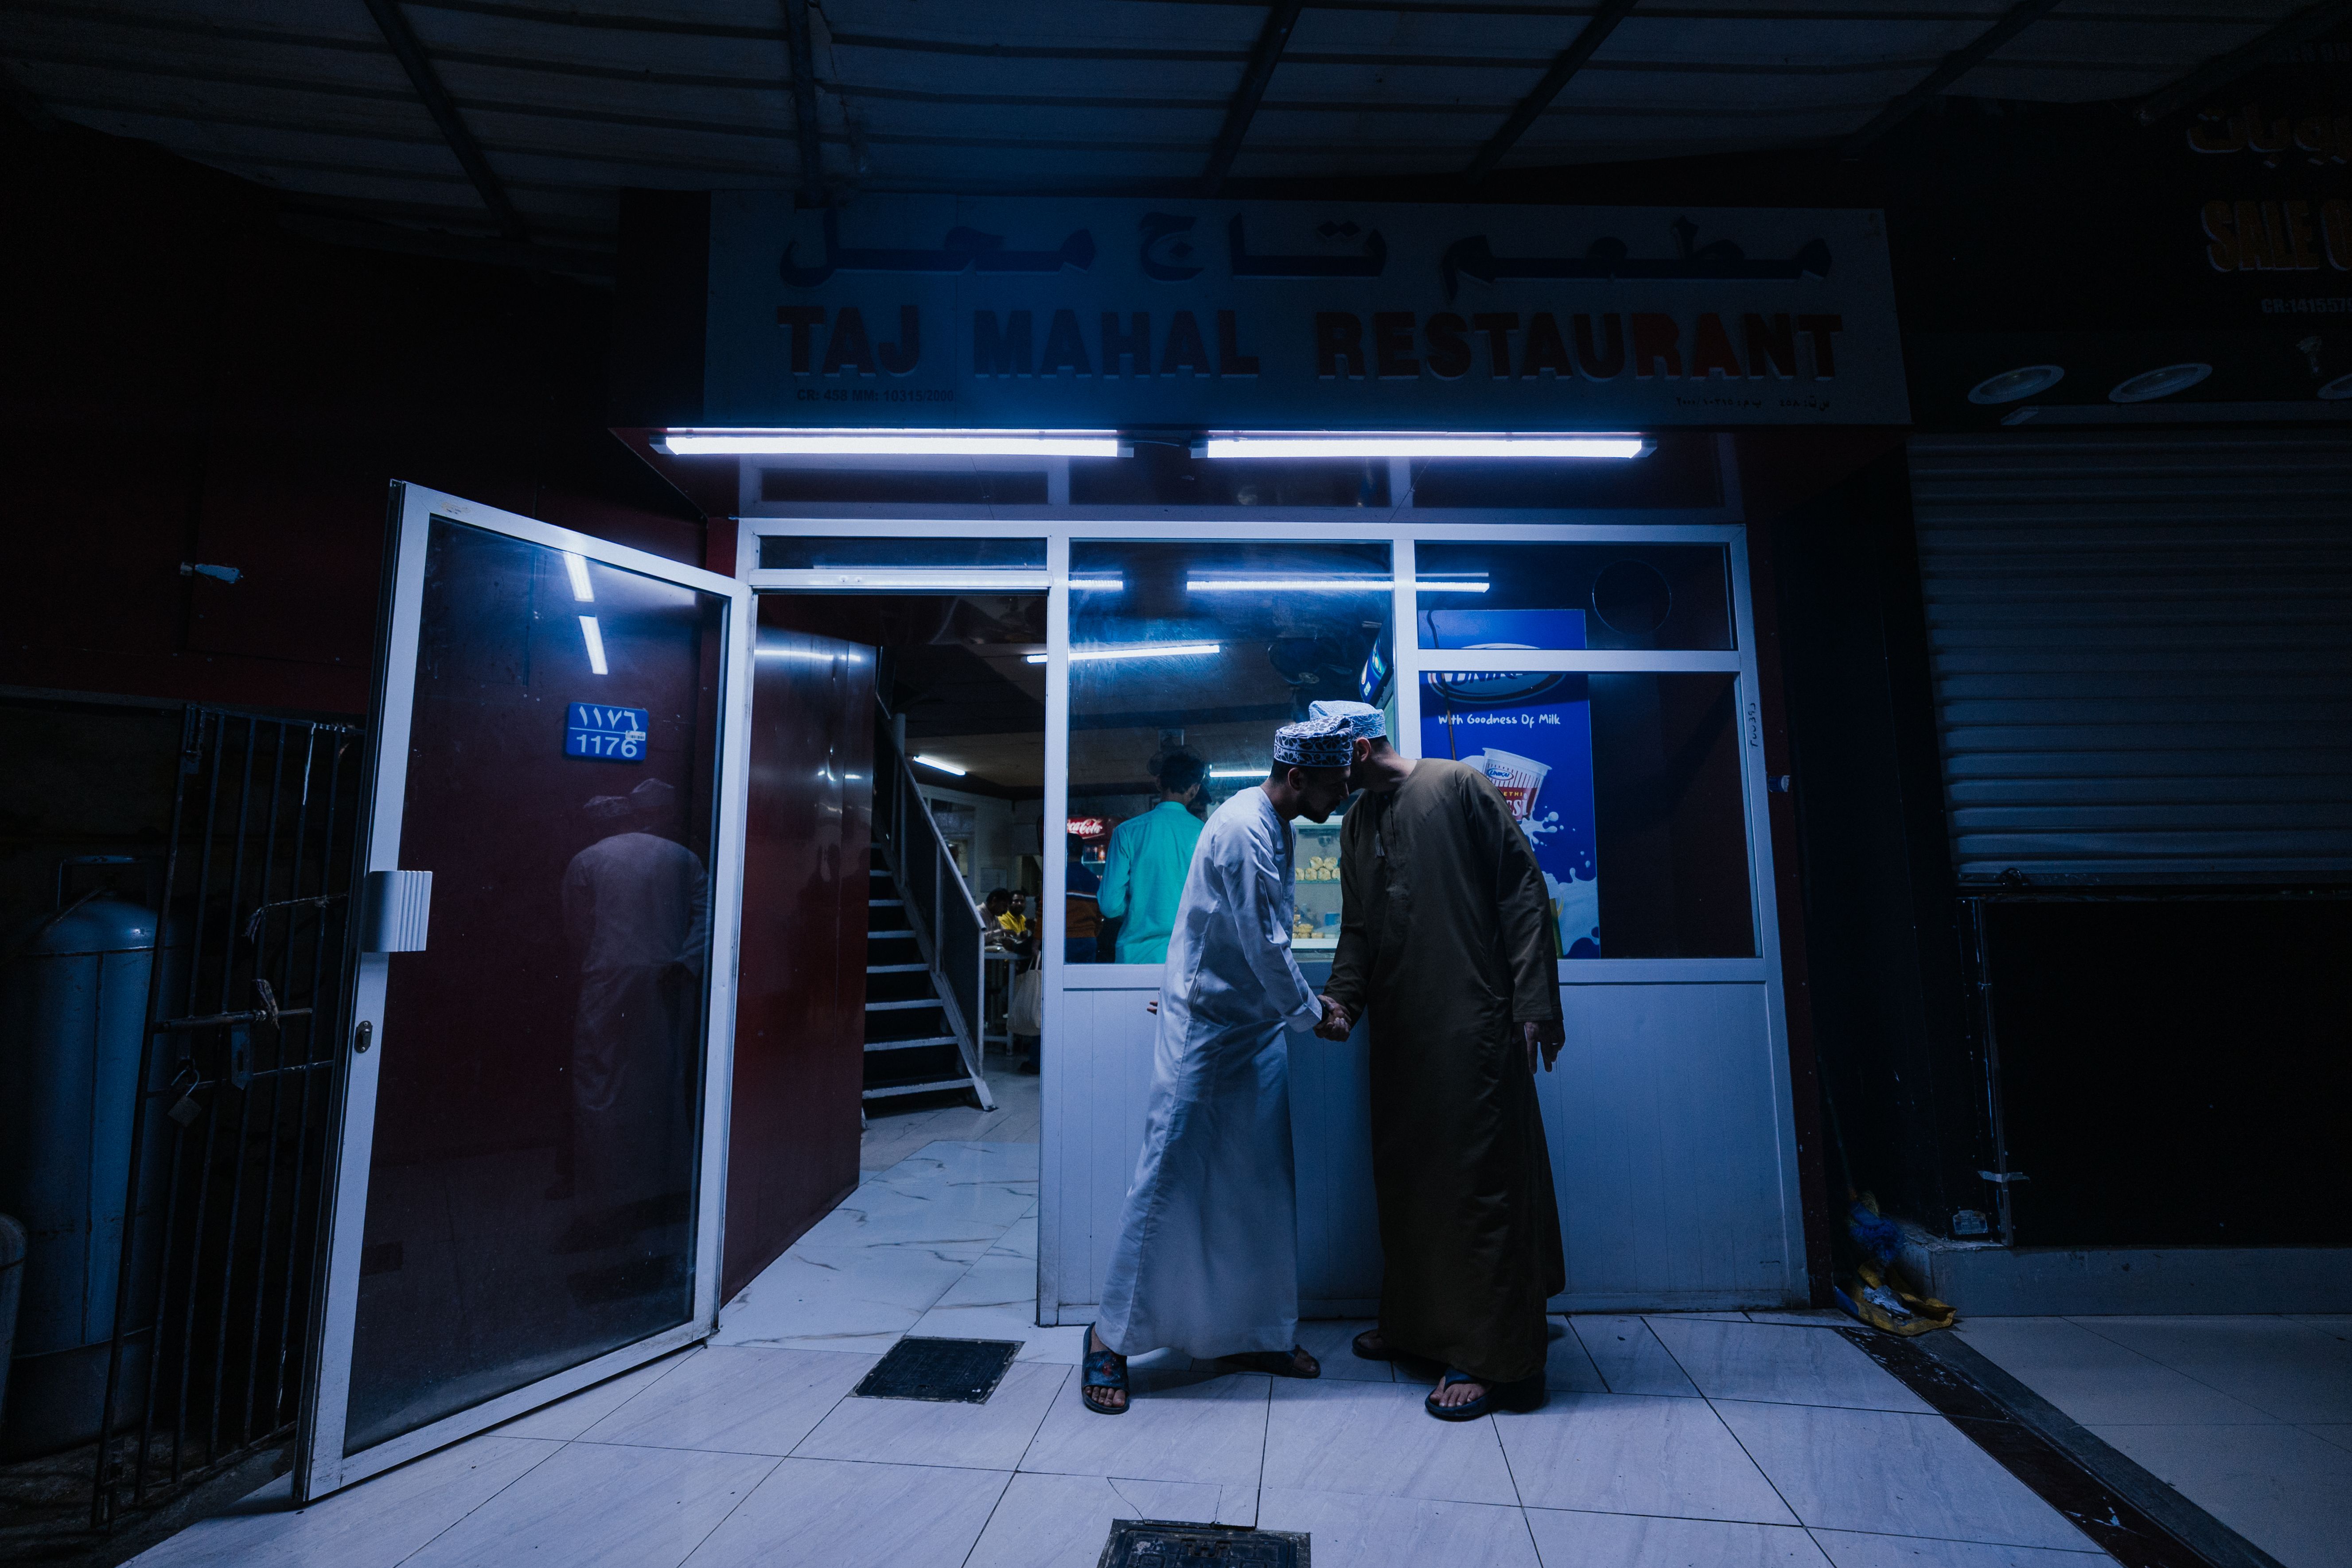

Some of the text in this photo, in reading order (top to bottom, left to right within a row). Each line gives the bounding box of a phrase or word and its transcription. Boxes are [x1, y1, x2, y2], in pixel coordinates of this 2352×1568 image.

[2201, 199, 2319, 272] SALE
[1441, 215, 1832, 303] مطعم
[777, 306, 1842, 381] TAJ MAHAL RESTAURANT
[797, 389, 954, 402] CR: 458 MM: 10315/2000
[579, 705, 639, 731] ١١٧٦
[1438, 713, 1561, 728] Wth Goodness Of Milk
[576, 734, 637, 758] 1176
